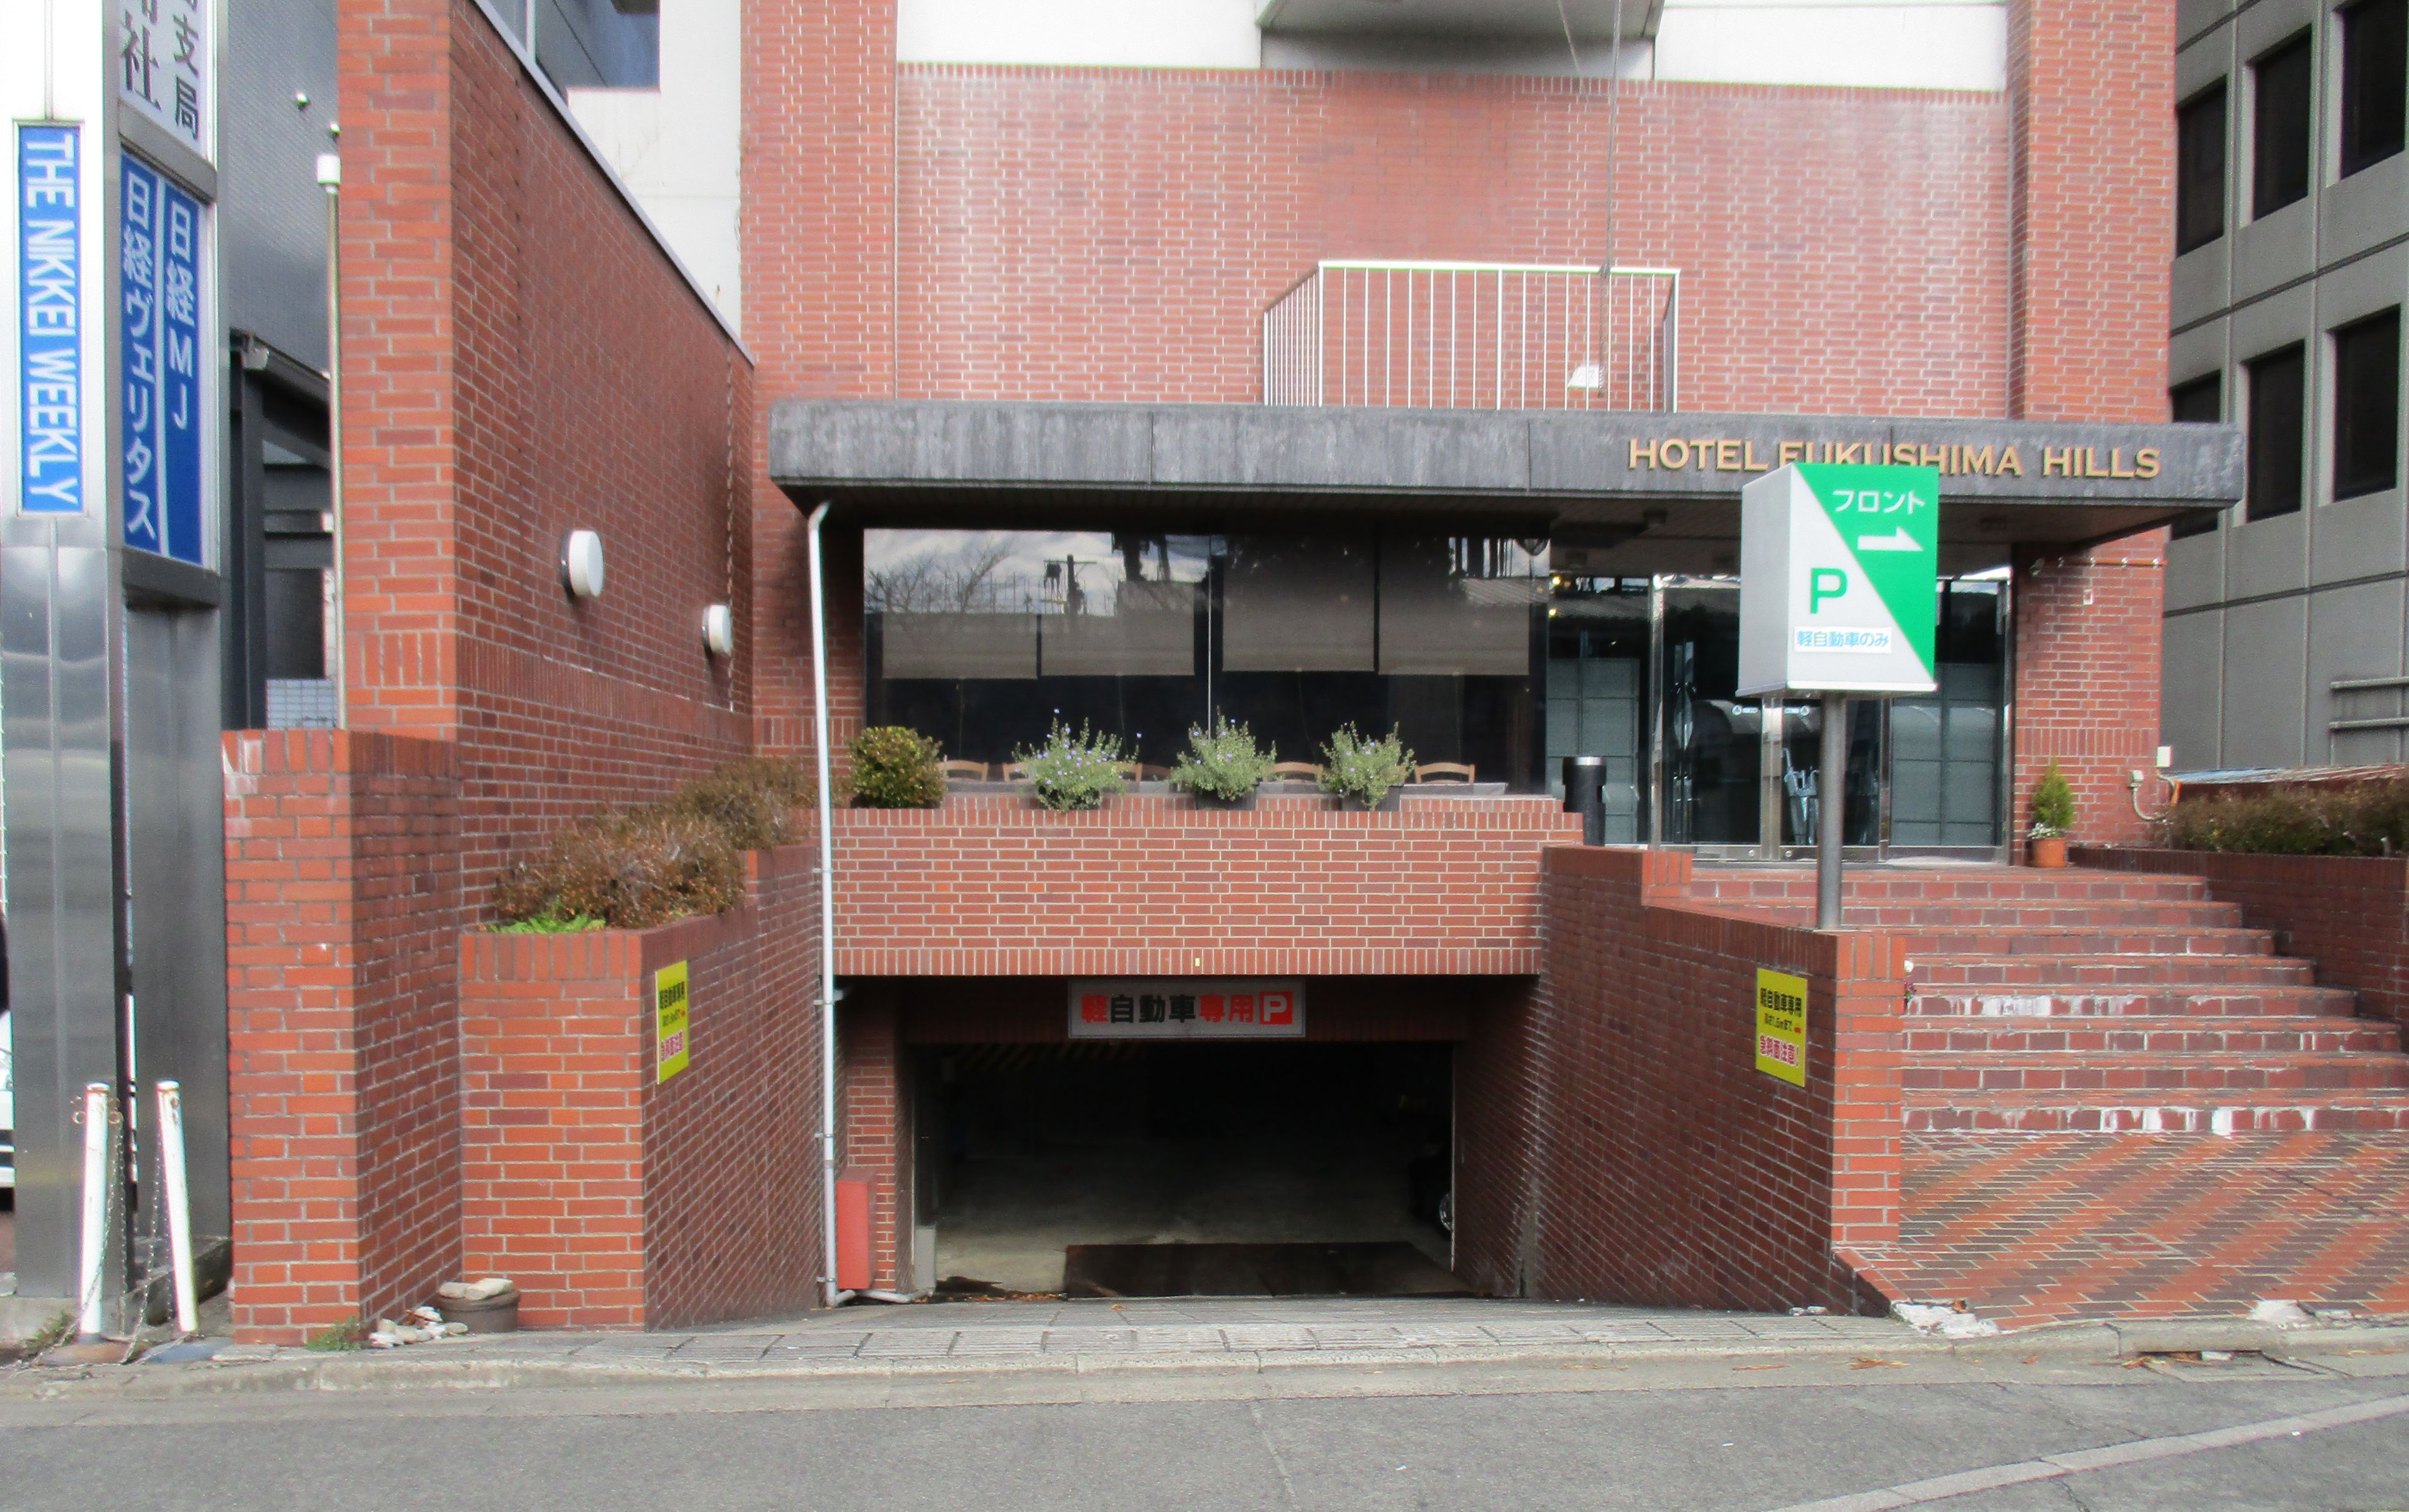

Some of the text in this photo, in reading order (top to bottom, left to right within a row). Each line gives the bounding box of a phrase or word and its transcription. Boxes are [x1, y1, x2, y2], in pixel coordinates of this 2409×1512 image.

[173, 0, 200, 141] 支局
[26, 132, 78, 505] THE NIKKEI WEEKLY
[123, 170, 156, 541] 日経ヴェリタス
[1629, 437, 2162, 479] HOTEL FUKUSHIMA HILLS
[1832, 489, 1926, 515] フロント
[1810, 567, 1848, 614] P
[1796, 630, 1890, 648] 軽自動車のみ
[1080, 993, 1255, 1024] 軽自動車専用
